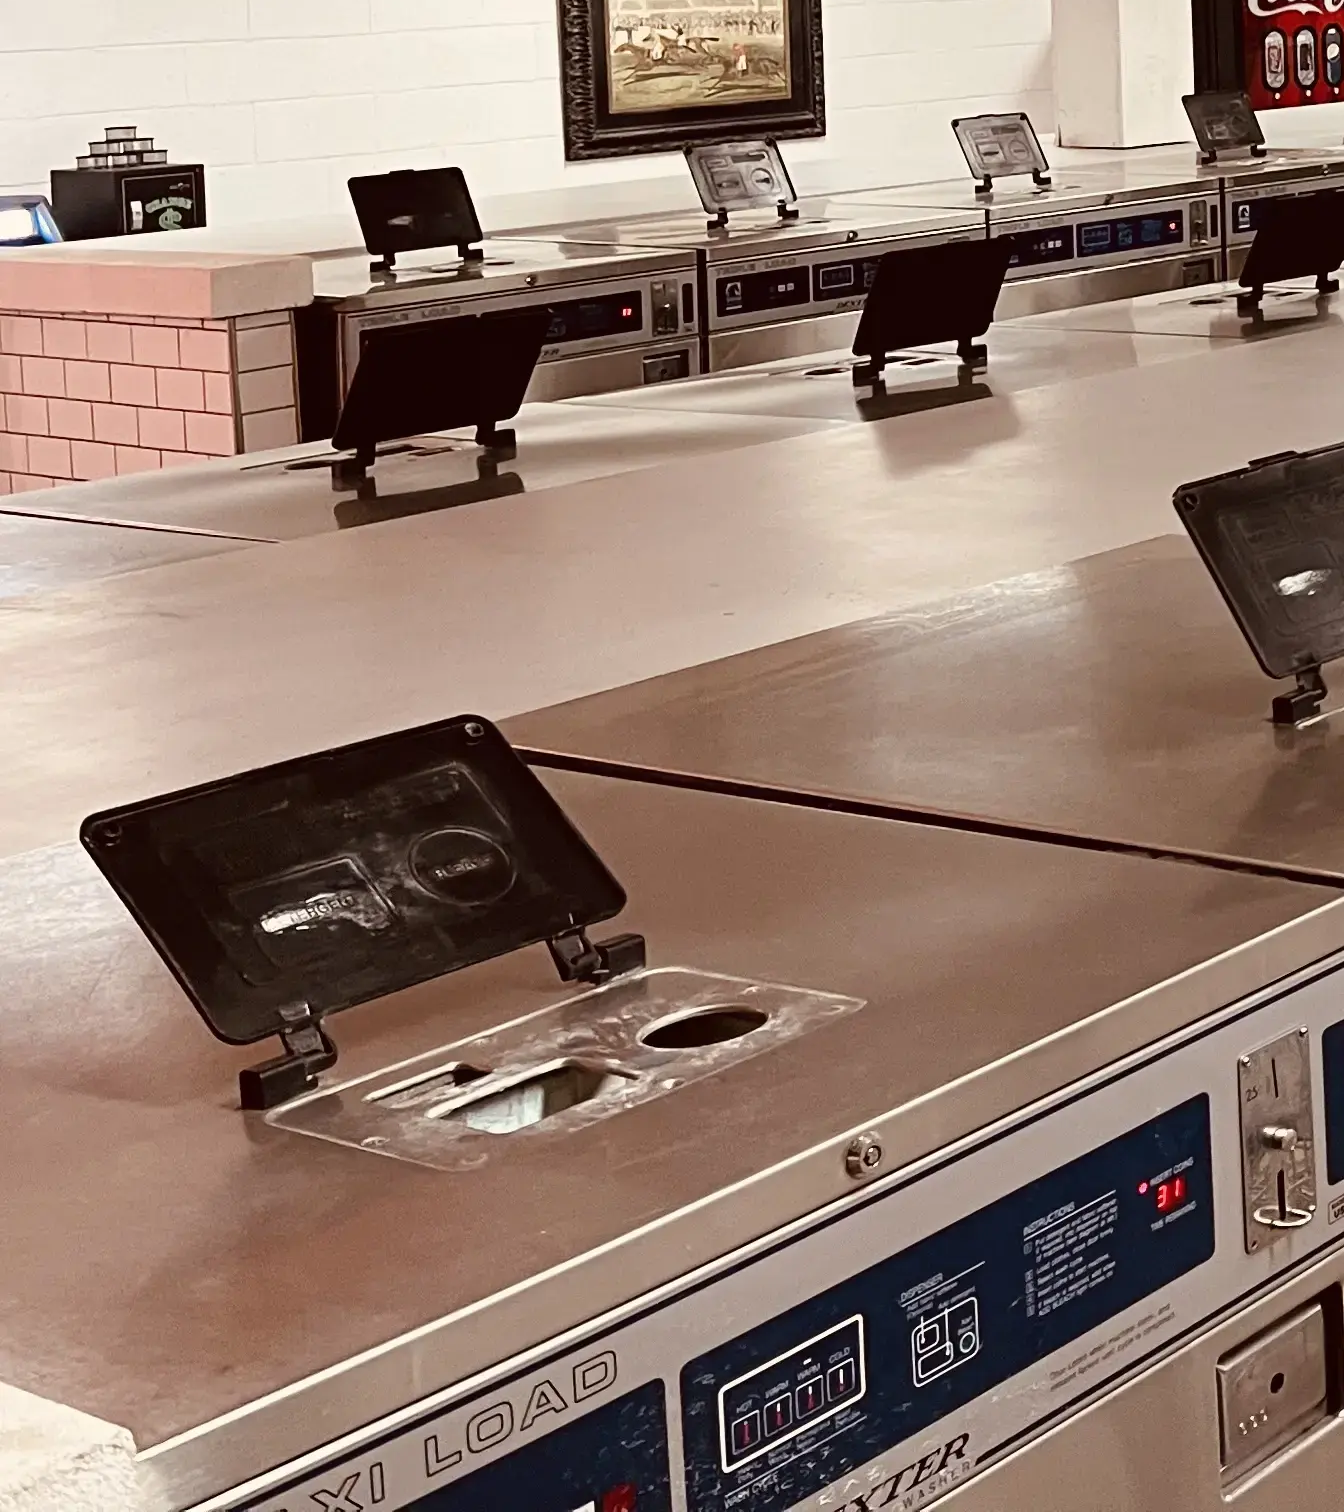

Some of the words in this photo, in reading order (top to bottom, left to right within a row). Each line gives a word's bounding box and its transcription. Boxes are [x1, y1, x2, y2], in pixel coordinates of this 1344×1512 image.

[1157, 1178, 1181, 1208] 31
[424, 1350, 617, 1478] LOAD
[902, 1461, 971, 1510] WASHER
